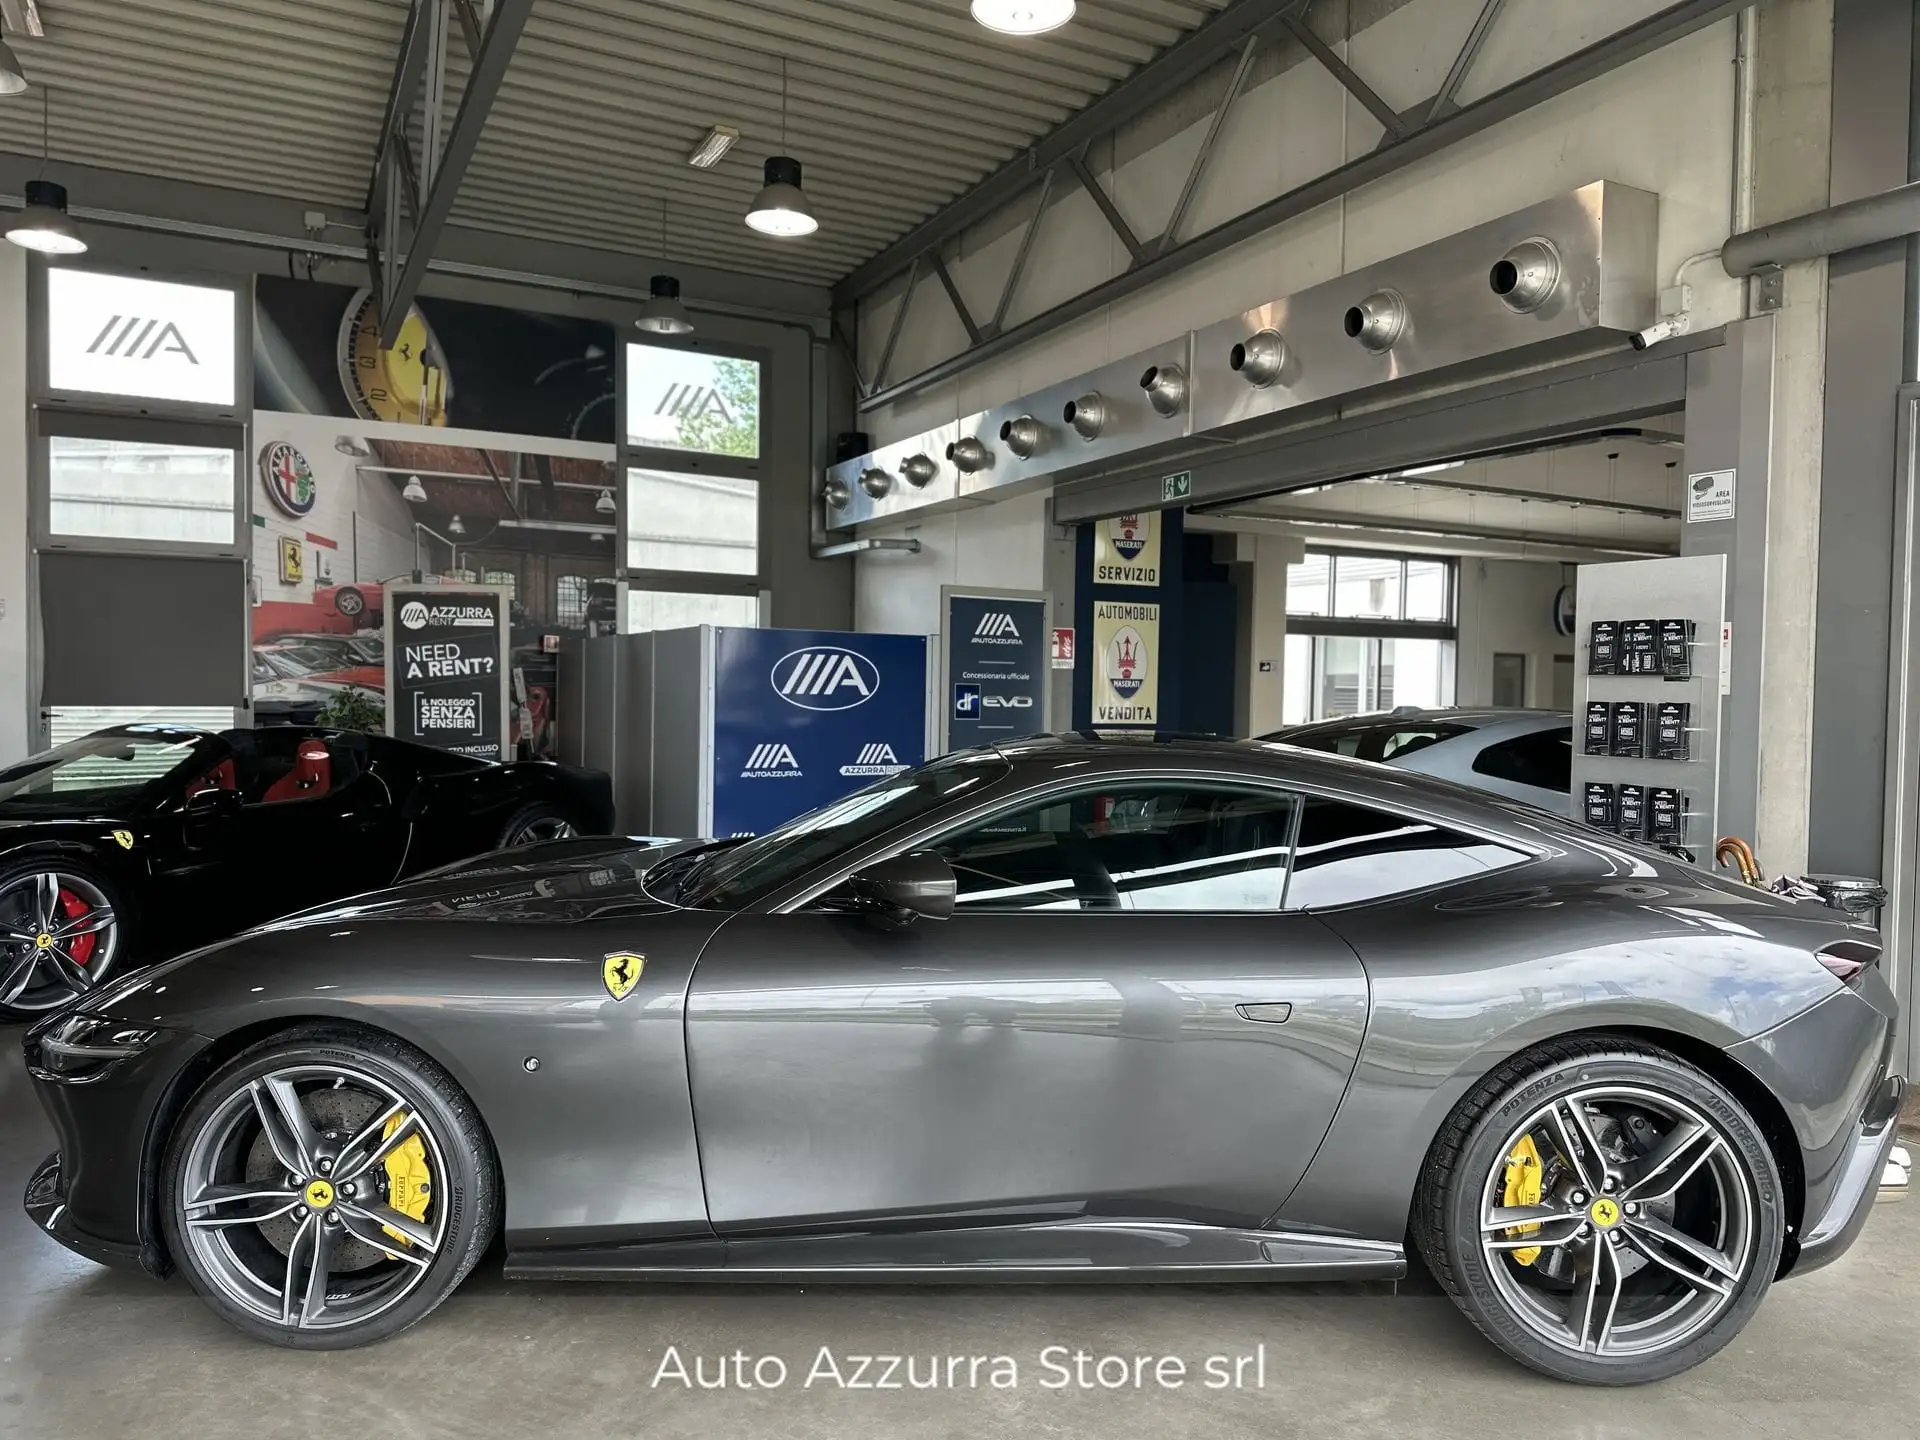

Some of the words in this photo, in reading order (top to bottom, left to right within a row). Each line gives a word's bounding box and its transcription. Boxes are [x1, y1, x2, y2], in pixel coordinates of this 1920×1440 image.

[1716, 490, 1730, 498] AREA
[1115, 540, 1142, 549] MASERATI
[1098, 565, 1156, 582] SERVIZIO
[430, 607, 494, 618] AZZURRA
[1098, 605, 1157, 621] AUTOMOBILI
[428, 618, 452, 626] RENT
[405, 644, 460, 662] NEED
[407, 662, 423, 679] A
[428, 657, 494, 677] RENT?
[962, 671, 1006, 680] Concessionaria
[1007, 672, 1030, 681] ufficiale
[1113, 680, 1141, 688] MASERATI
[431, 698, 476, 707] NOLEGGIO
[982, 696, 1033, 708] EVO
[421, 706, 476, 719] SENZA
[1099, 706, 1152, 721] VENDITA
[422, 719, 475, 729] PENSIERI
[465, 744, 499, 753] INCLUSO
[844, 767, 885, 775] AZZURRA
[1501, 1073, 1565, 1116] POTENZA
[445, 1185, 464, 1256] BRIDGESTONE
